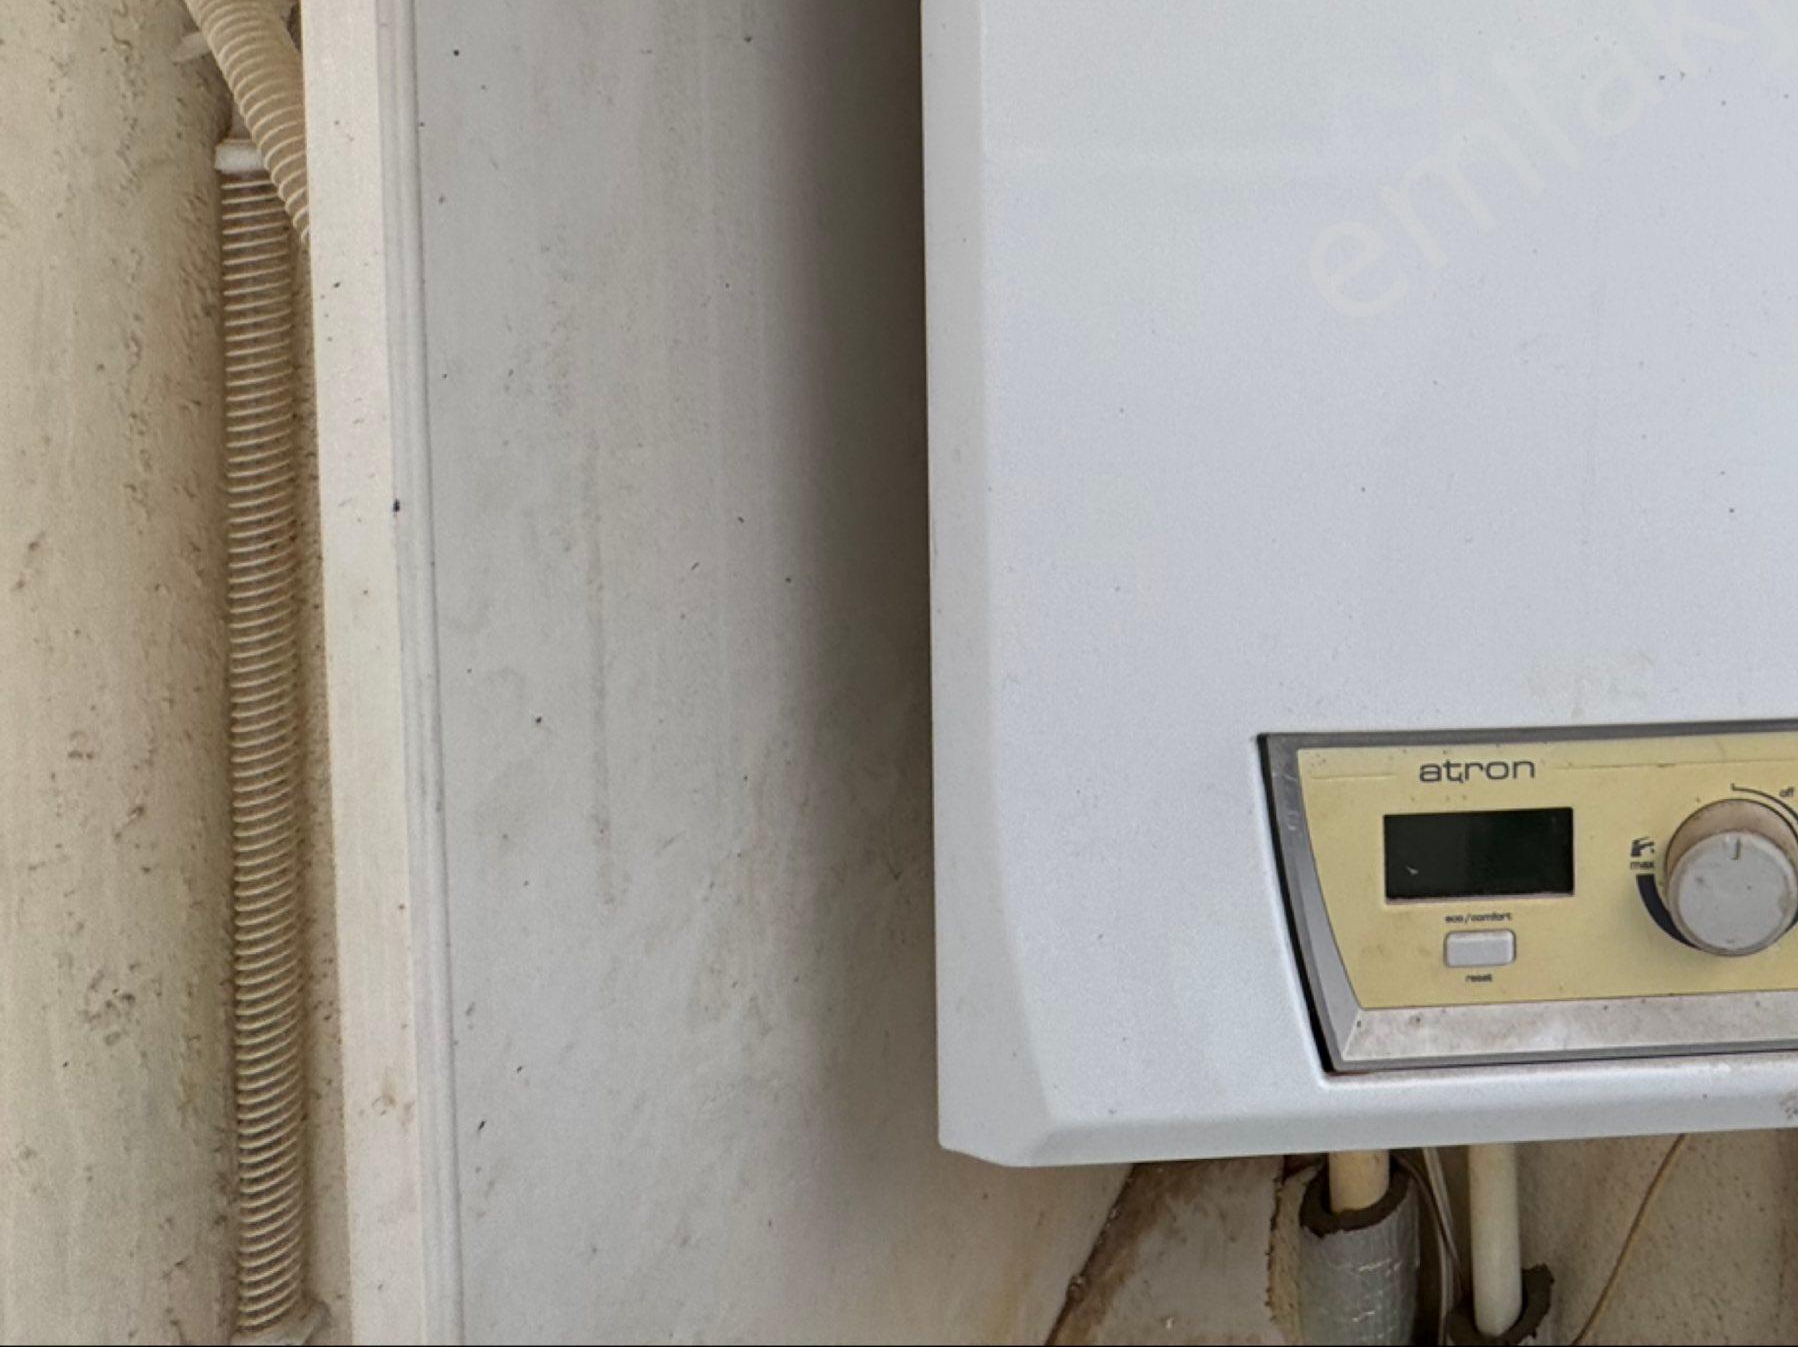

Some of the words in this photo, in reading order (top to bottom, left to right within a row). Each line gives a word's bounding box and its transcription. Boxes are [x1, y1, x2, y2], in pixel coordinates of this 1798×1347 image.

[1419, 758, 1536, 784] atron
[1630, 861, 1655, 871] max
[1465, 972, 1493, 984] reset
